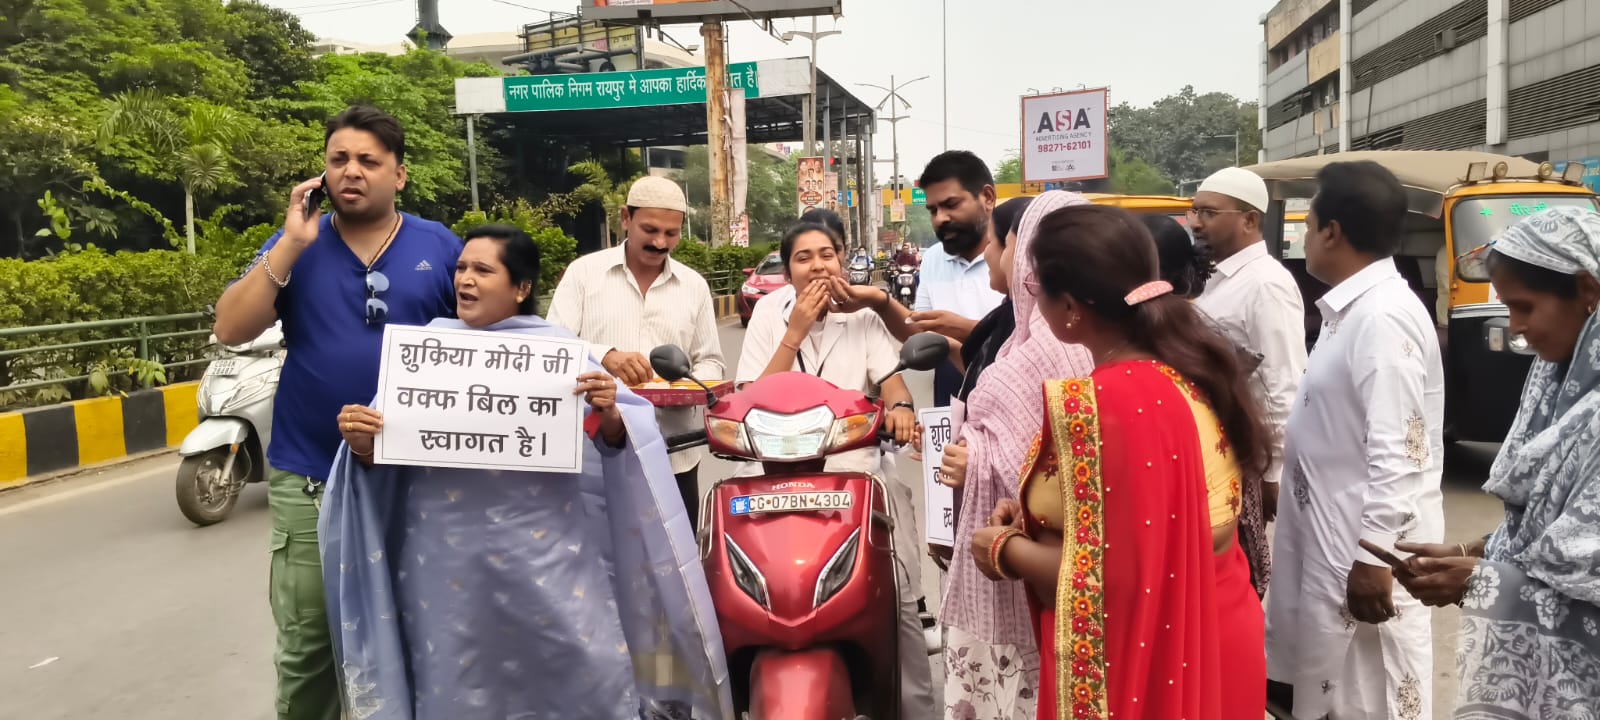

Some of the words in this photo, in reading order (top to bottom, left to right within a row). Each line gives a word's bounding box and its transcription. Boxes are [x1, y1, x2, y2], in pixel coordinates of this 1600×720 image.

[508, 83, 529, 101] नगर
[531, 79, 564, 100] पालिक
[568, 79, 593, 98] निगम
[596, 80, 625, 102] रायपुर
[639, 77, 673, 96] आपका
[1037, 108, 1091, 133] ASA
[1038, 141, 1091, 152] 98271-62101
[399, 337, 478, 373] शुक्रिया
[484, 343, 535, 373] मोदी
[541, 347, 574, 375] जी
[396, 386, 459, 411] वक्फ
[466, 384, 519, 416] बिल
[527, 396, 562, 417] का
[418, 429, 509, 454] स्वागत
[514, 426, 547, 458] है।
[771, 481, 816, 491] HONDA
